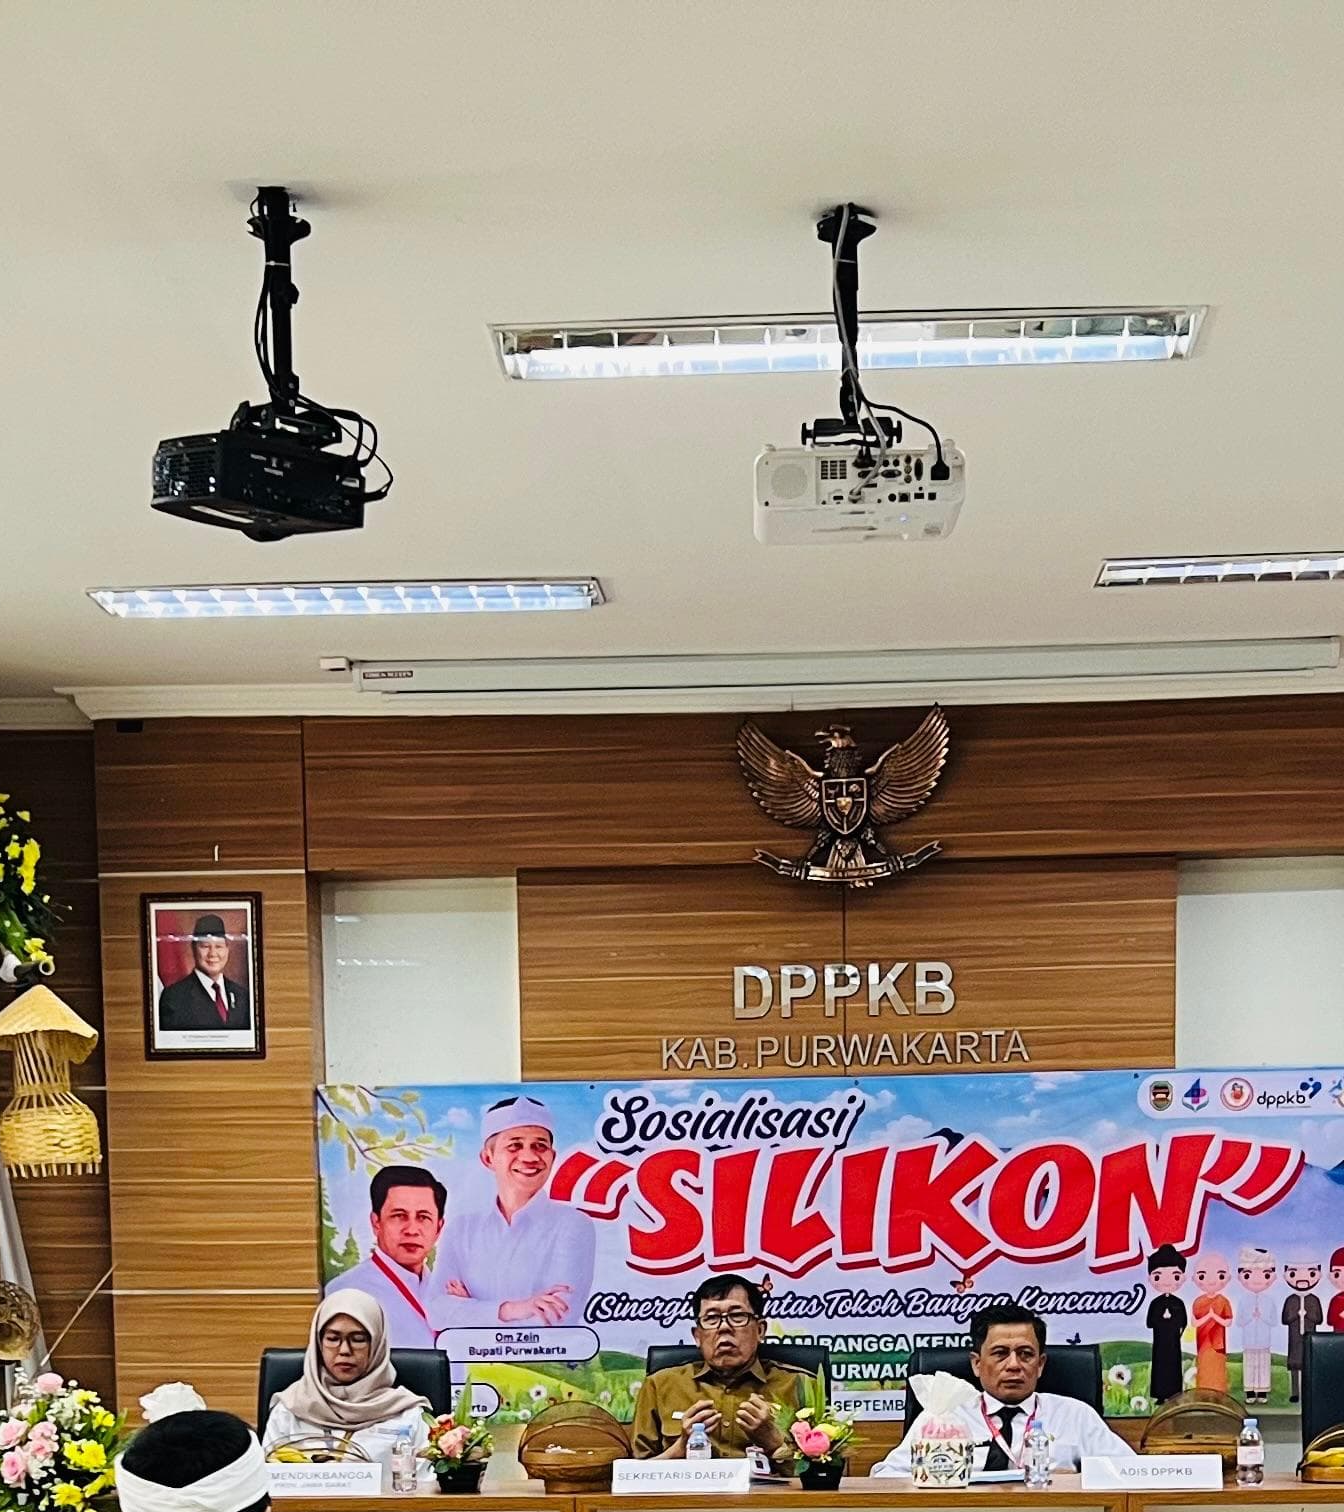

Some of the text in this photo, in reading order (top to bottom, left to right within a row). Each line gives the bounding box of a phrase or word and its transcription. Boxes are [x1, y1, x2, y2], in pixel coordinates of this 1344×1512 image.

[731, 961, 956, 1020] DPPKB
[660, 1029, 1031, 1072] KAB. PURWAKARTA
[1256, 1090, 1307, 1109] dppkb
[600, 1094, 866, 1148] Sosialisasi
[585, 1291, 695, 1328] (Sinergi
[825, 1289, 901, 1317] Tokoh
[1018, 1285, 1147, 1315] Kencana)
[495, 1332, 540, 1343] Om Zein
[820, 1336, 910, 1353] BANGGA
[468, 1345, 568, 1357] Bupati Purwakarta
[831, 1362, 909, 1381] URWAK
[833, 1399, 906, 1412] SEPTEMB
[271, 1471, 374, 1481] MENDUKBANGGA
[618, 1471, 735, 1482] SEKRETARIS DAERA
[1119, 1466, 1194, 1477] ADIS DPPKB
